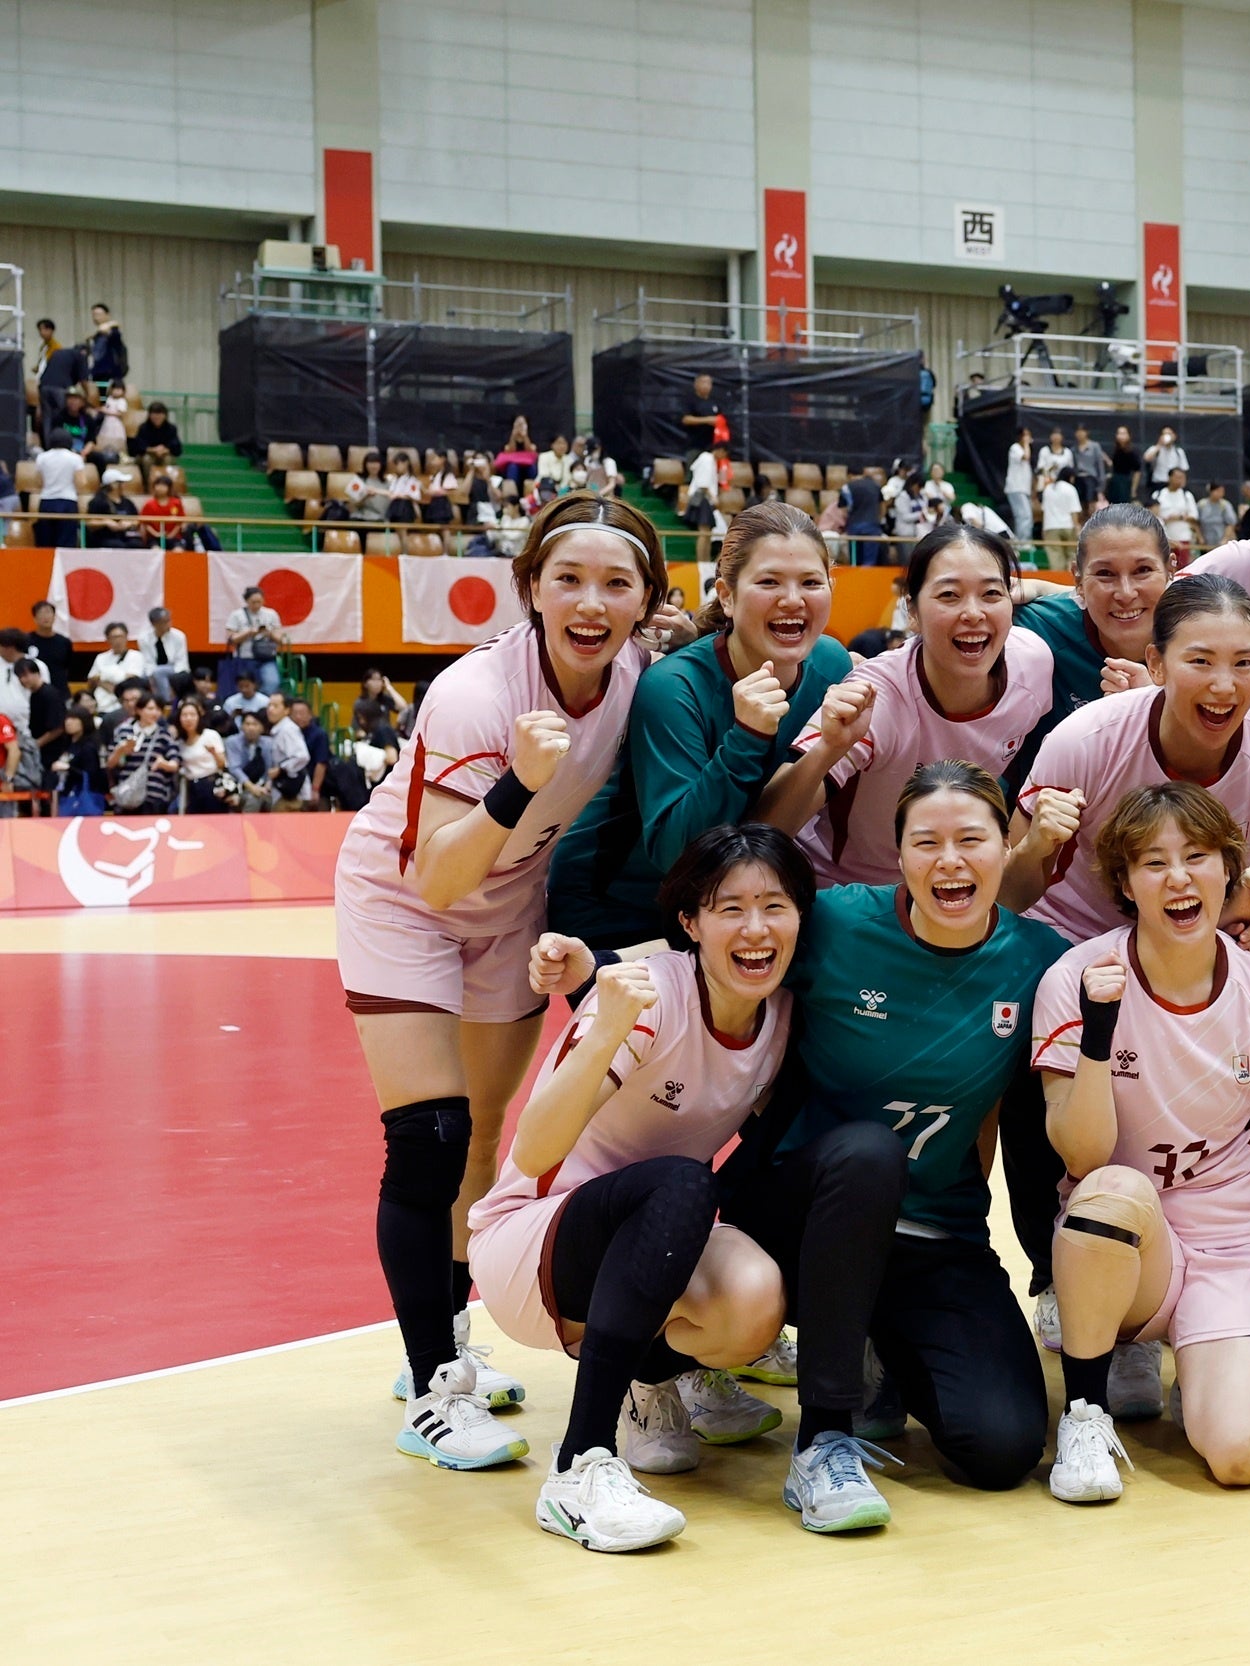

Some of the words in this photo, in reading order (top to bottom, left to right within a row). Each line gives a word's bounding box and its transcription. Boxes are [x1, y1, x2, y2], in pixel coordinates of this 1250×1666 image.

[962, 210, 994, 245] 西
[853, 1006, 888, 1020] hummel
[1110, 1069, 1140, 1080] hummel
[650, 1093, 681, 1111] hummel
[882, 1100, 954, 1161] 77
